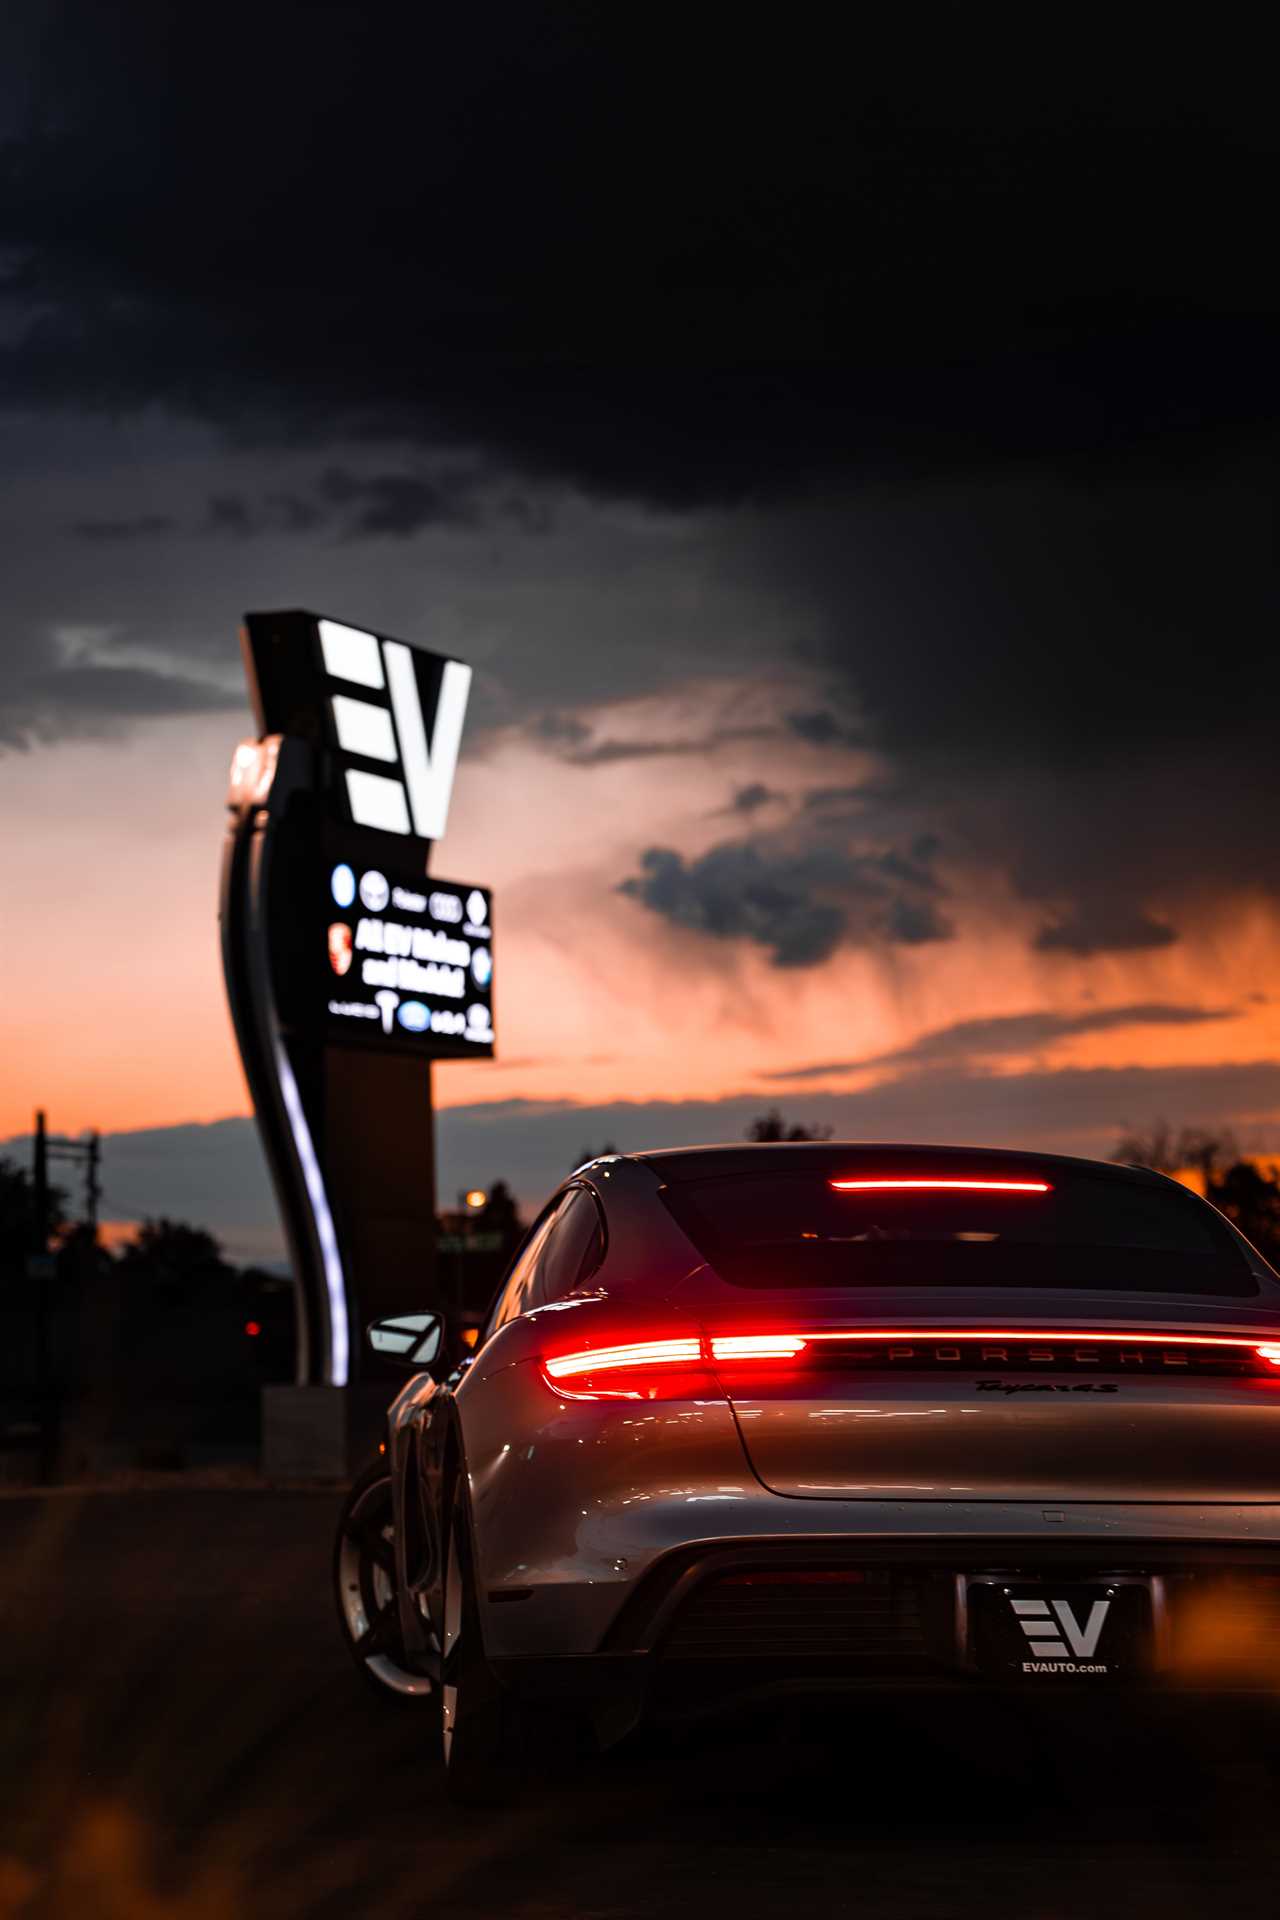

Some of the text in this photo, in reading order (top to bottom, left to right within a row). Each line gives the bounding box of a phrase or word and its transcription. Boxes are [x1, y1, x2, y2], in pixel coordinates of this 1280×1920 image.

[317, 619, 472, 840] EV
[888, 1346, 1190, 1367] PORSCHE
[1009, 1599, 1111, 1658] EV
[1021, 1661, 1107, 1674] EVAUTO.com
